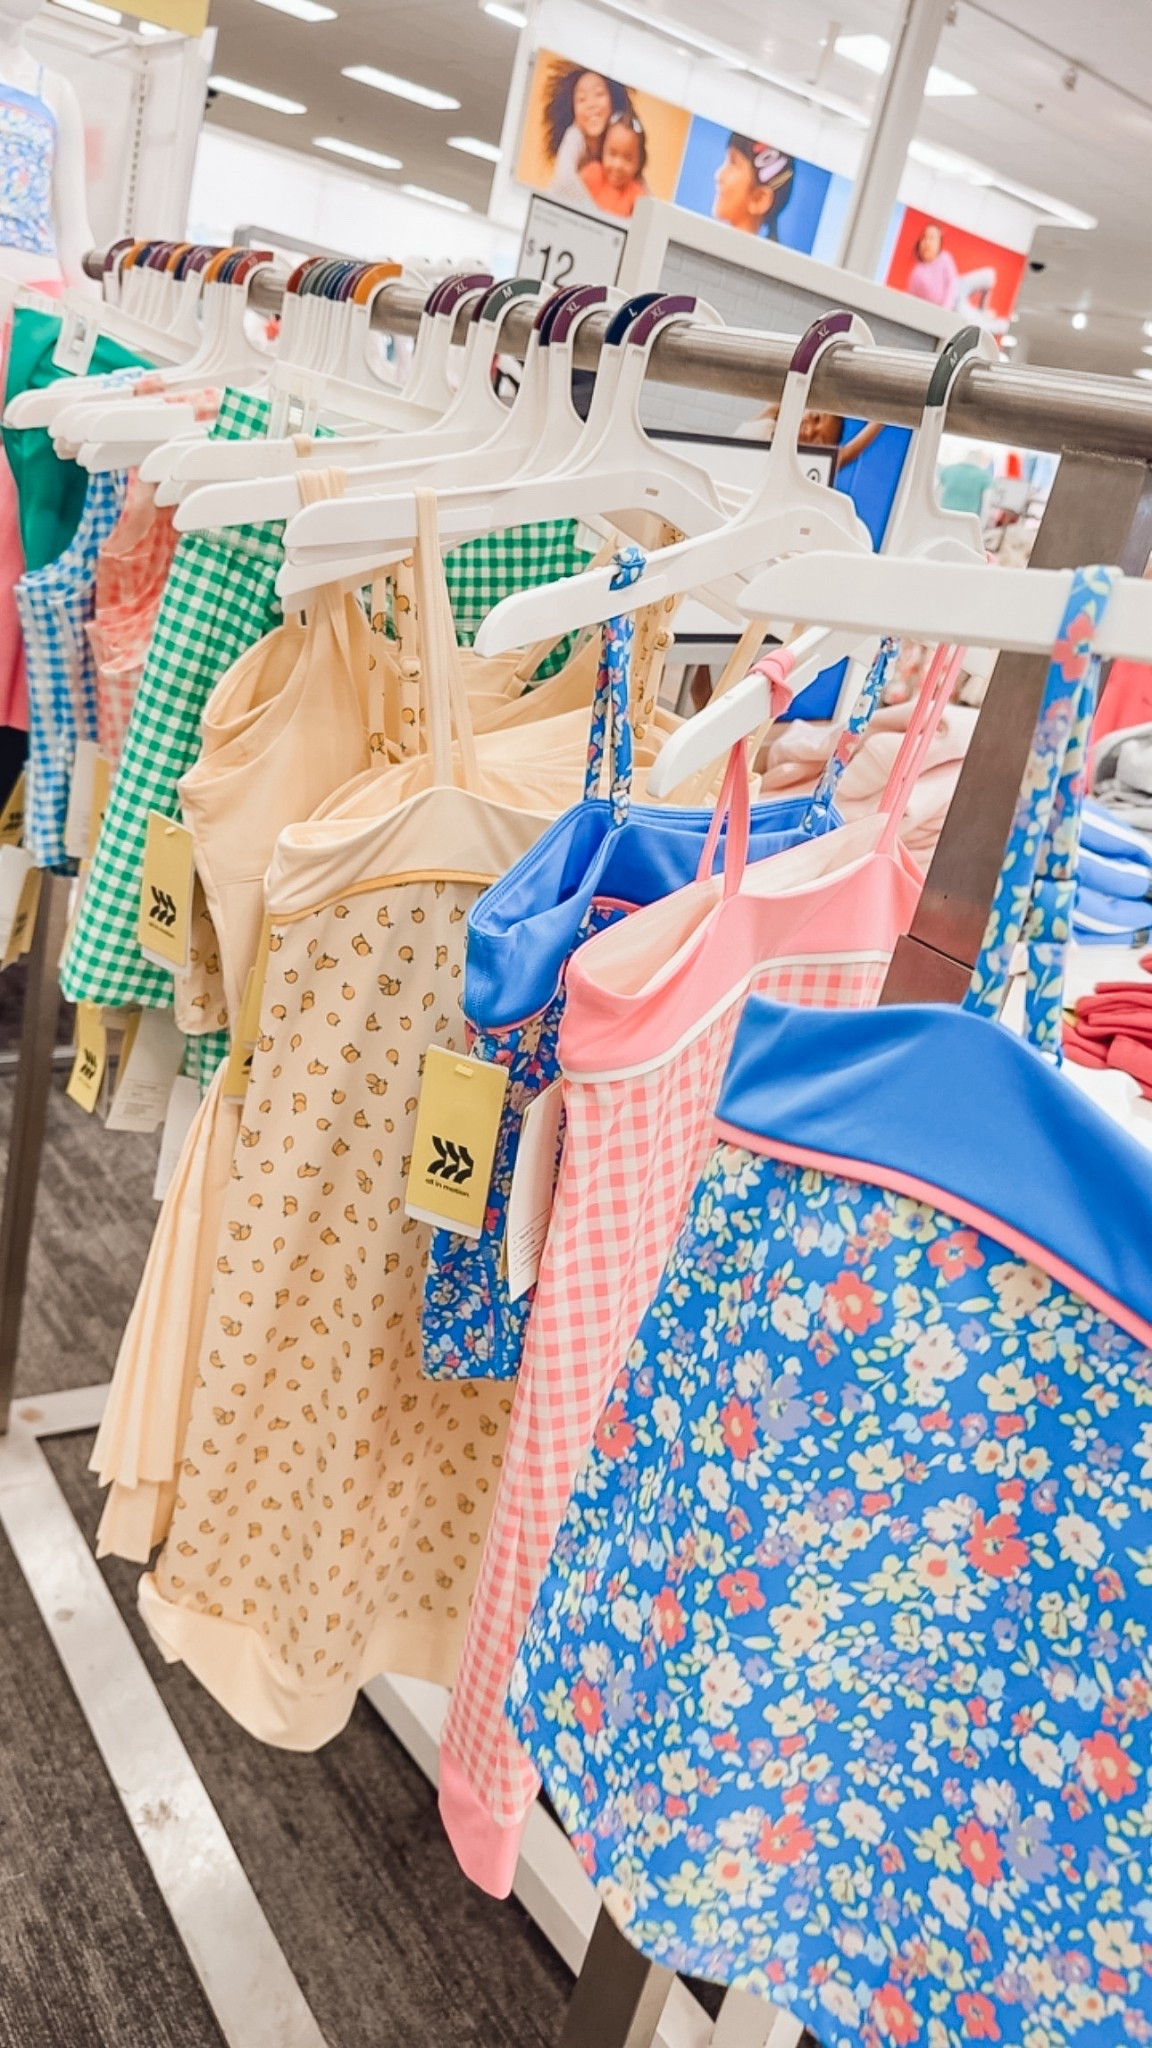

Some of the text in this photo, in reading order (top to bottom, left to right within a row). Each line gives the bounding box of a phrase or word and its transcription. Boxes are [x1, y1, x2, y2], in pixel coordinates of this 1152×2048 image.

[454, 282, 468, 295] XL
[502, 286, 513, 299] M
[566, 301, 580, 316] XL
[628, 307, 638, 318] L
[651, 306, 666, 320] XL
